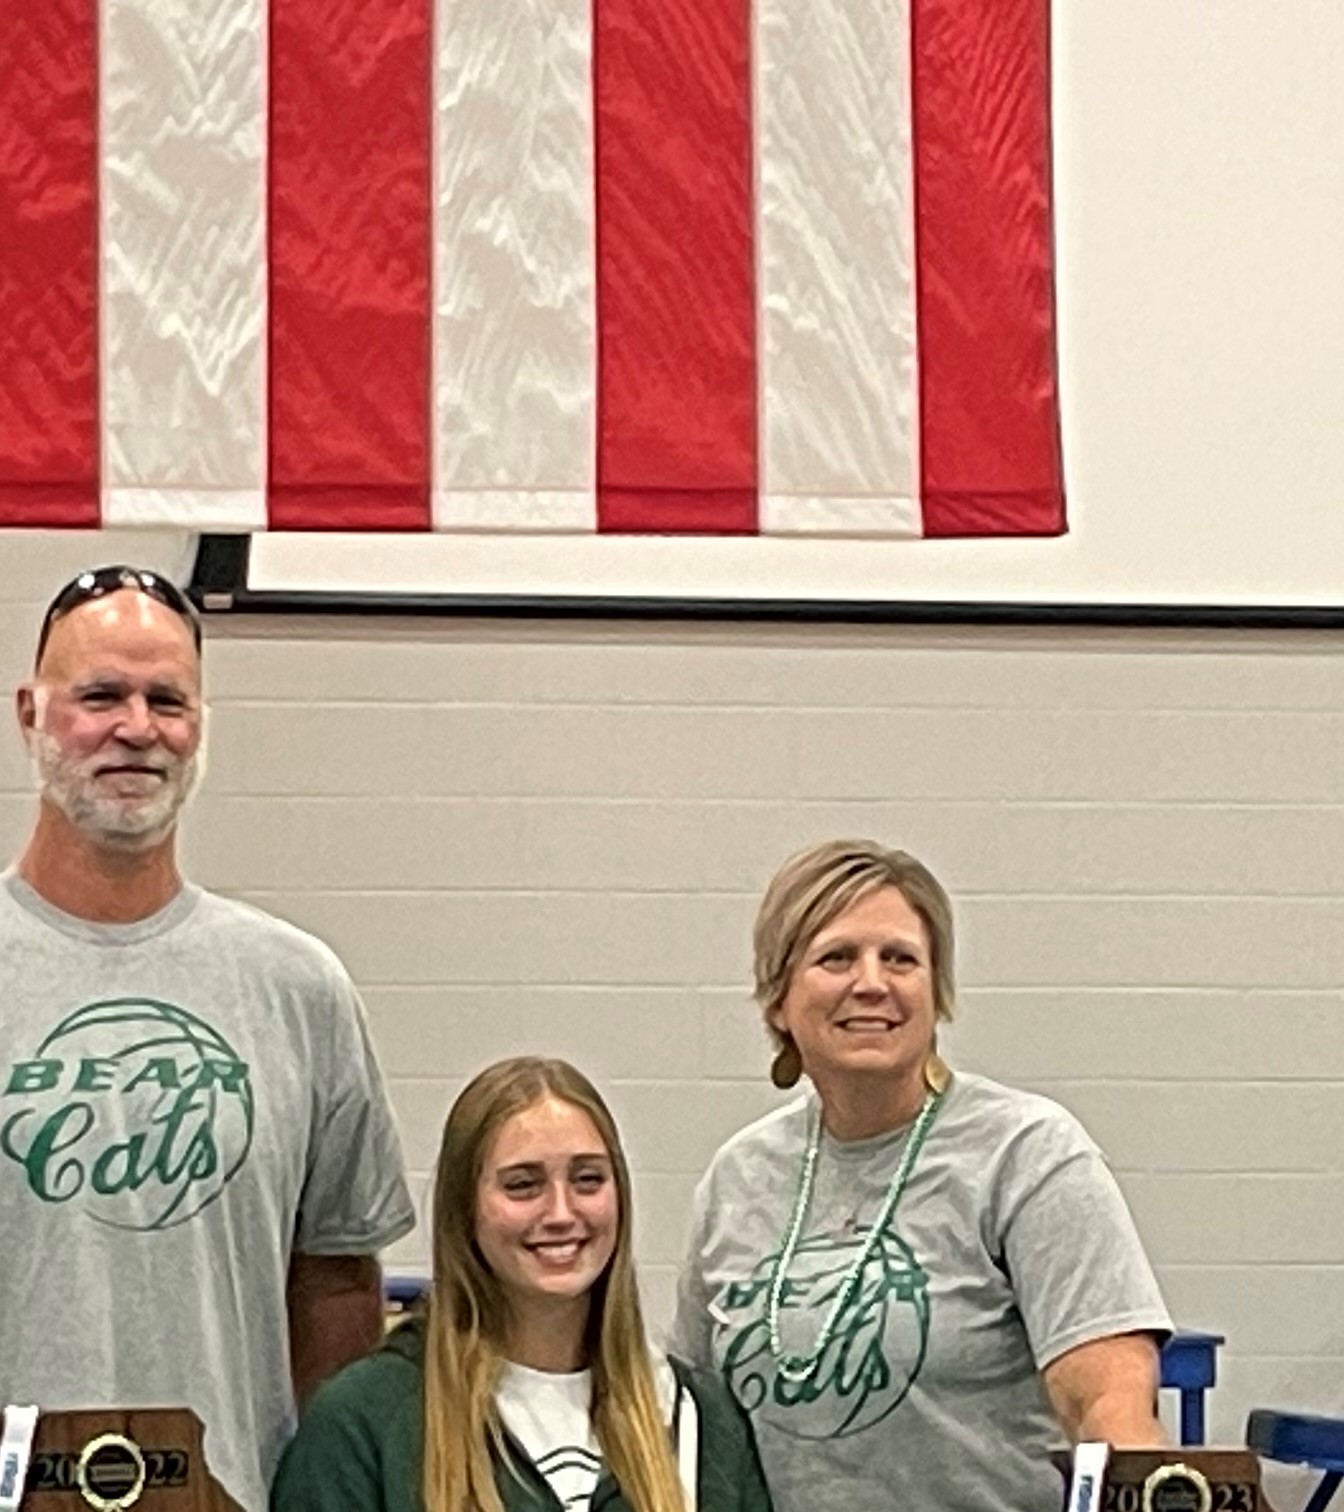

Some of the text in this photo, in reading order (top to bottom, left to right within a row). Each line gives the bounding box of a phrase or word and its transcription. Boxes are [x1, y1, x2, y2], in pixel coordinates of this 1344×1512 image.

[2, 1057, 250, 1097] BEAR
[0, 1086, 217, 1202] Cats
[147, 1452, 187, 1486] 22
